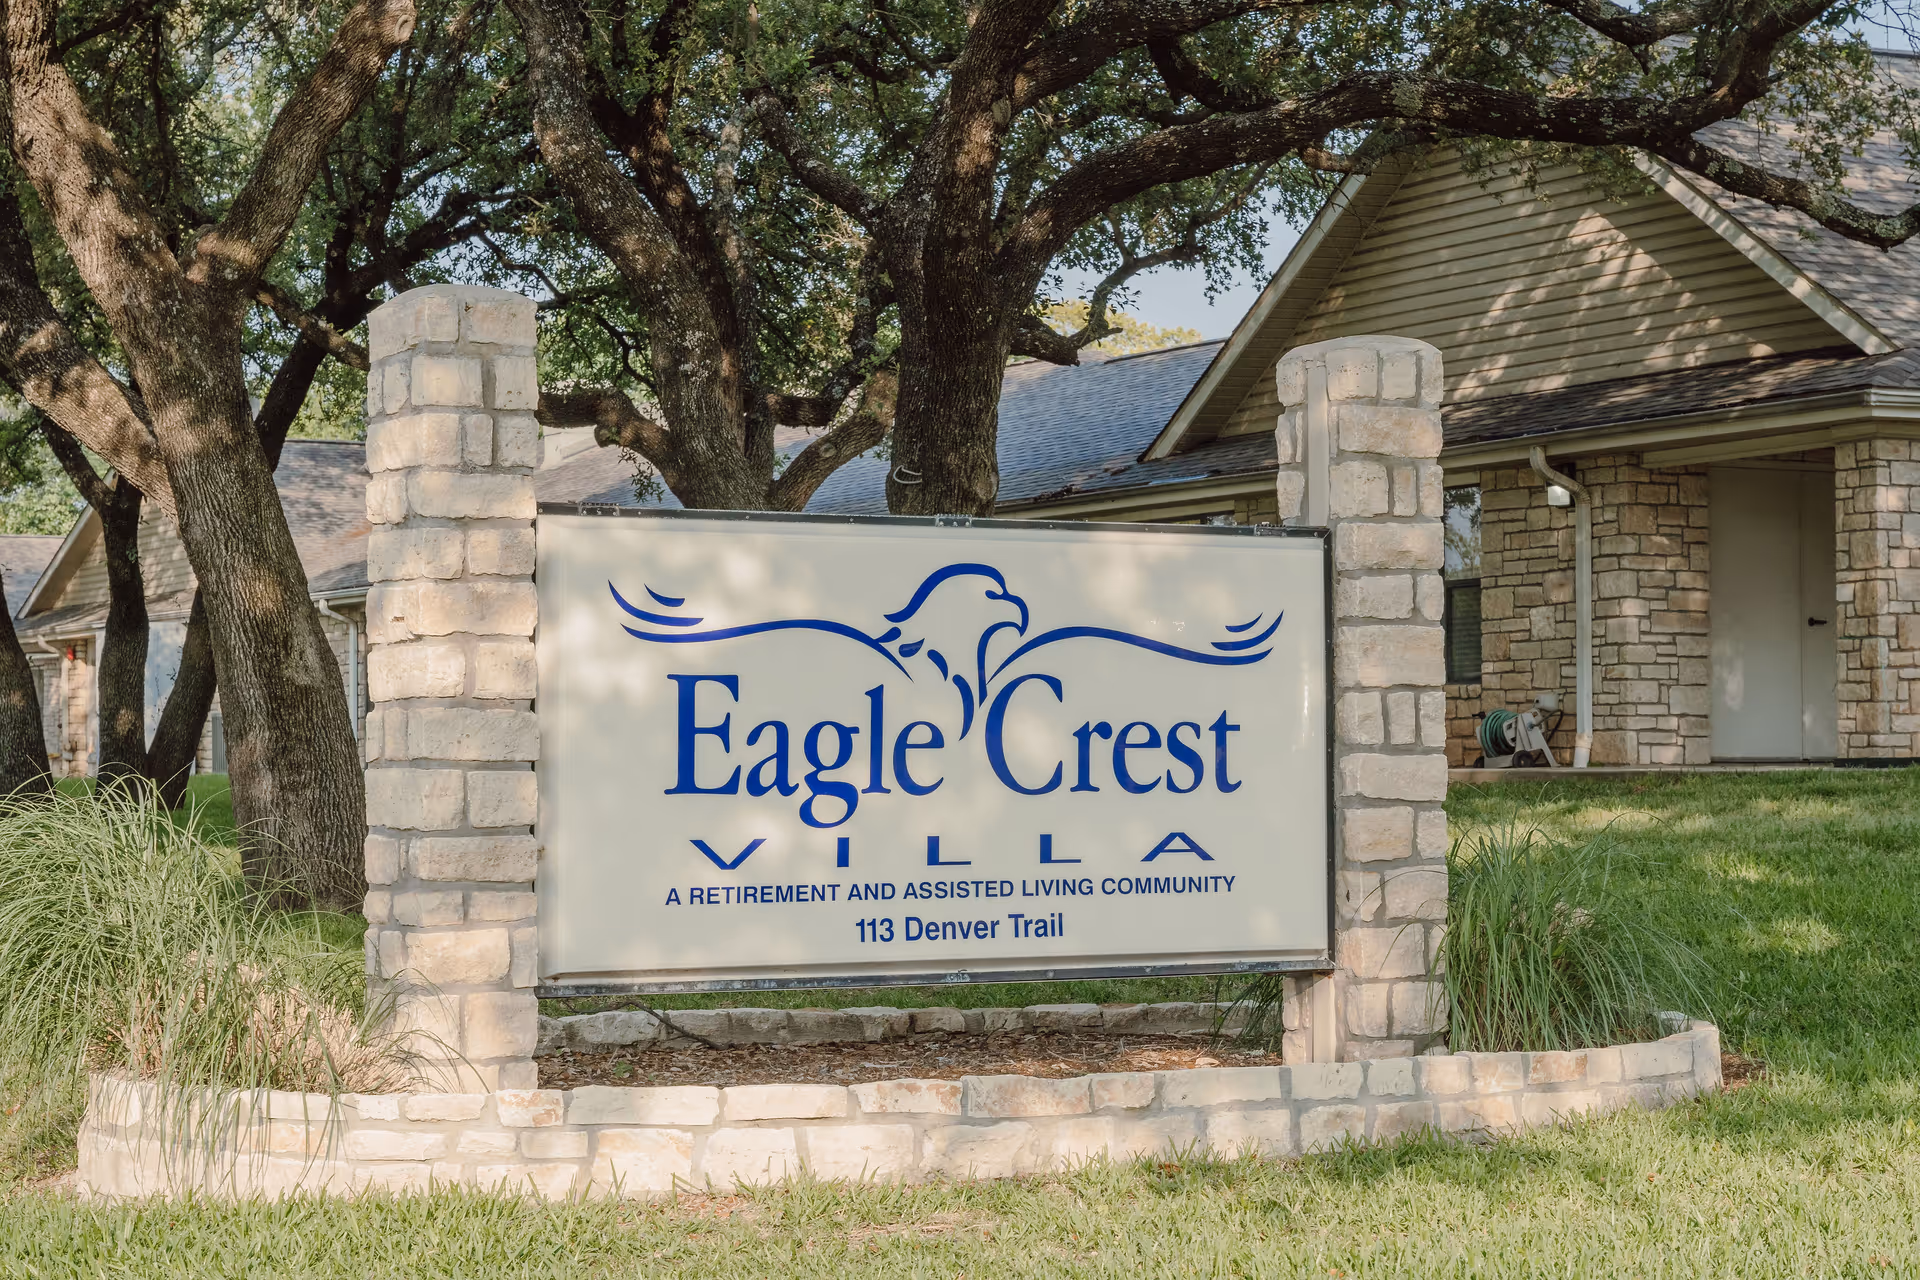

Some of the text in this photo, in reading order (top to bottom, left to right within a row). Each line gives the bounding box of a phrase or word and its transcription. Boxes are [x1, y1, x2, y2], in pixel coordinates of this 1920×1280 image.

[665, 673, 1243, 829] Eagle Crest
[690, 831, 1214, 871] VILLA
[666, 875, 1236, 906] A RETIREMENT AND ASSISTED LIVING COMMUNITY
[855, 912, 1064, 943] 113 Denver Trail
